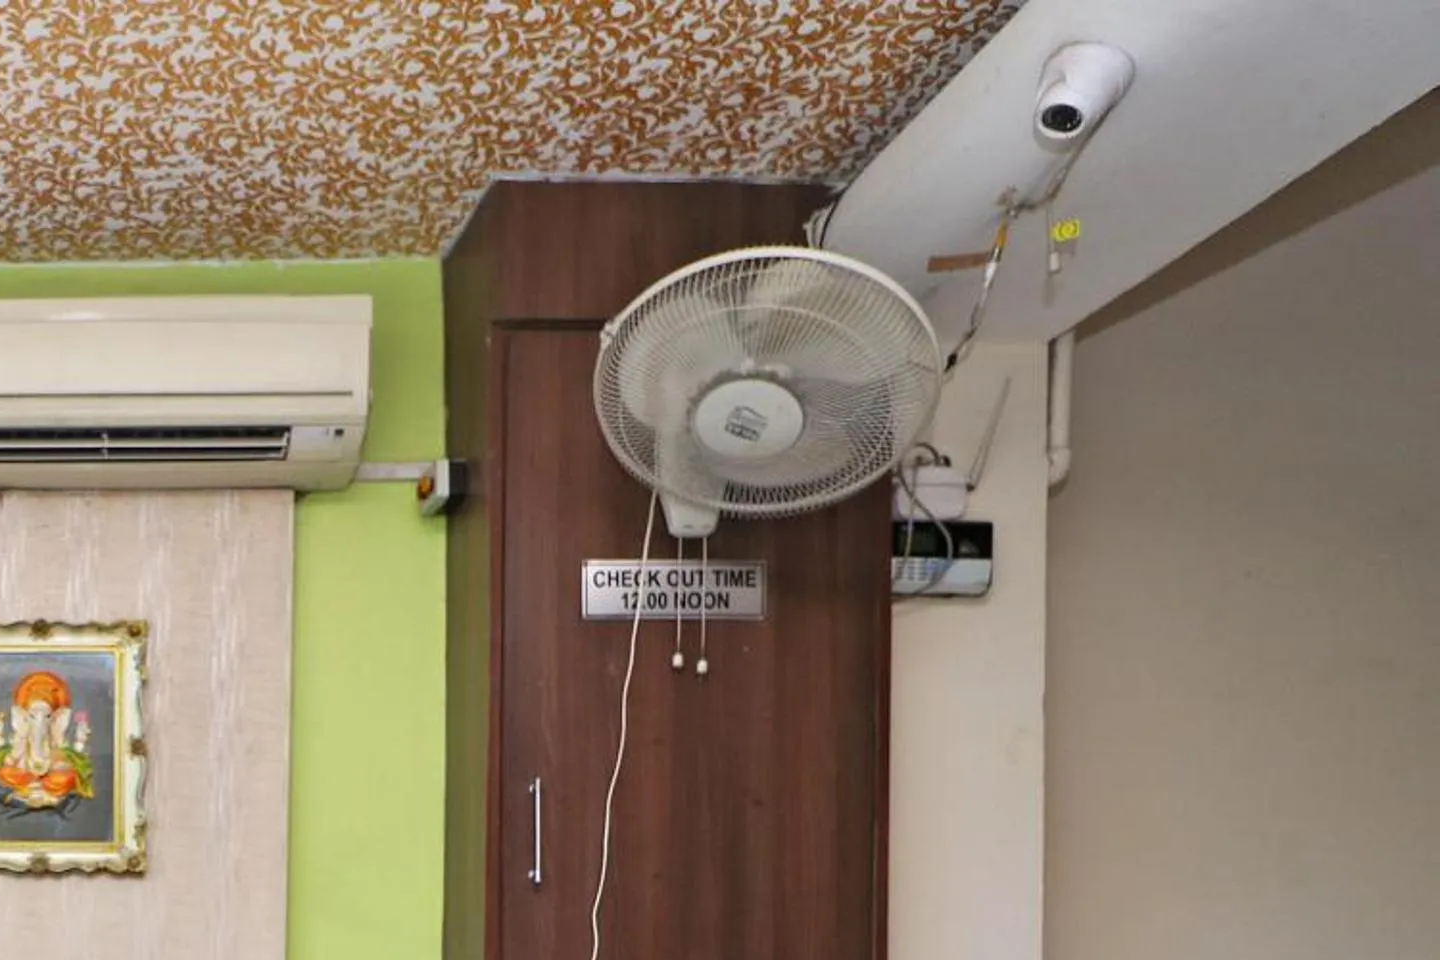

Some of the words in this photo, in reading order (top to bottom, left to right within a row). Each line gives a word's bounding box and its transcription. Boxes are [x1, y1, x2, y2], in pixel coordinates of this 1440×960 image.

[593, 570, 660, 588] CHECK
[712, 569, 757, 588] TIME
[673, 592, 730, 610] NOON
